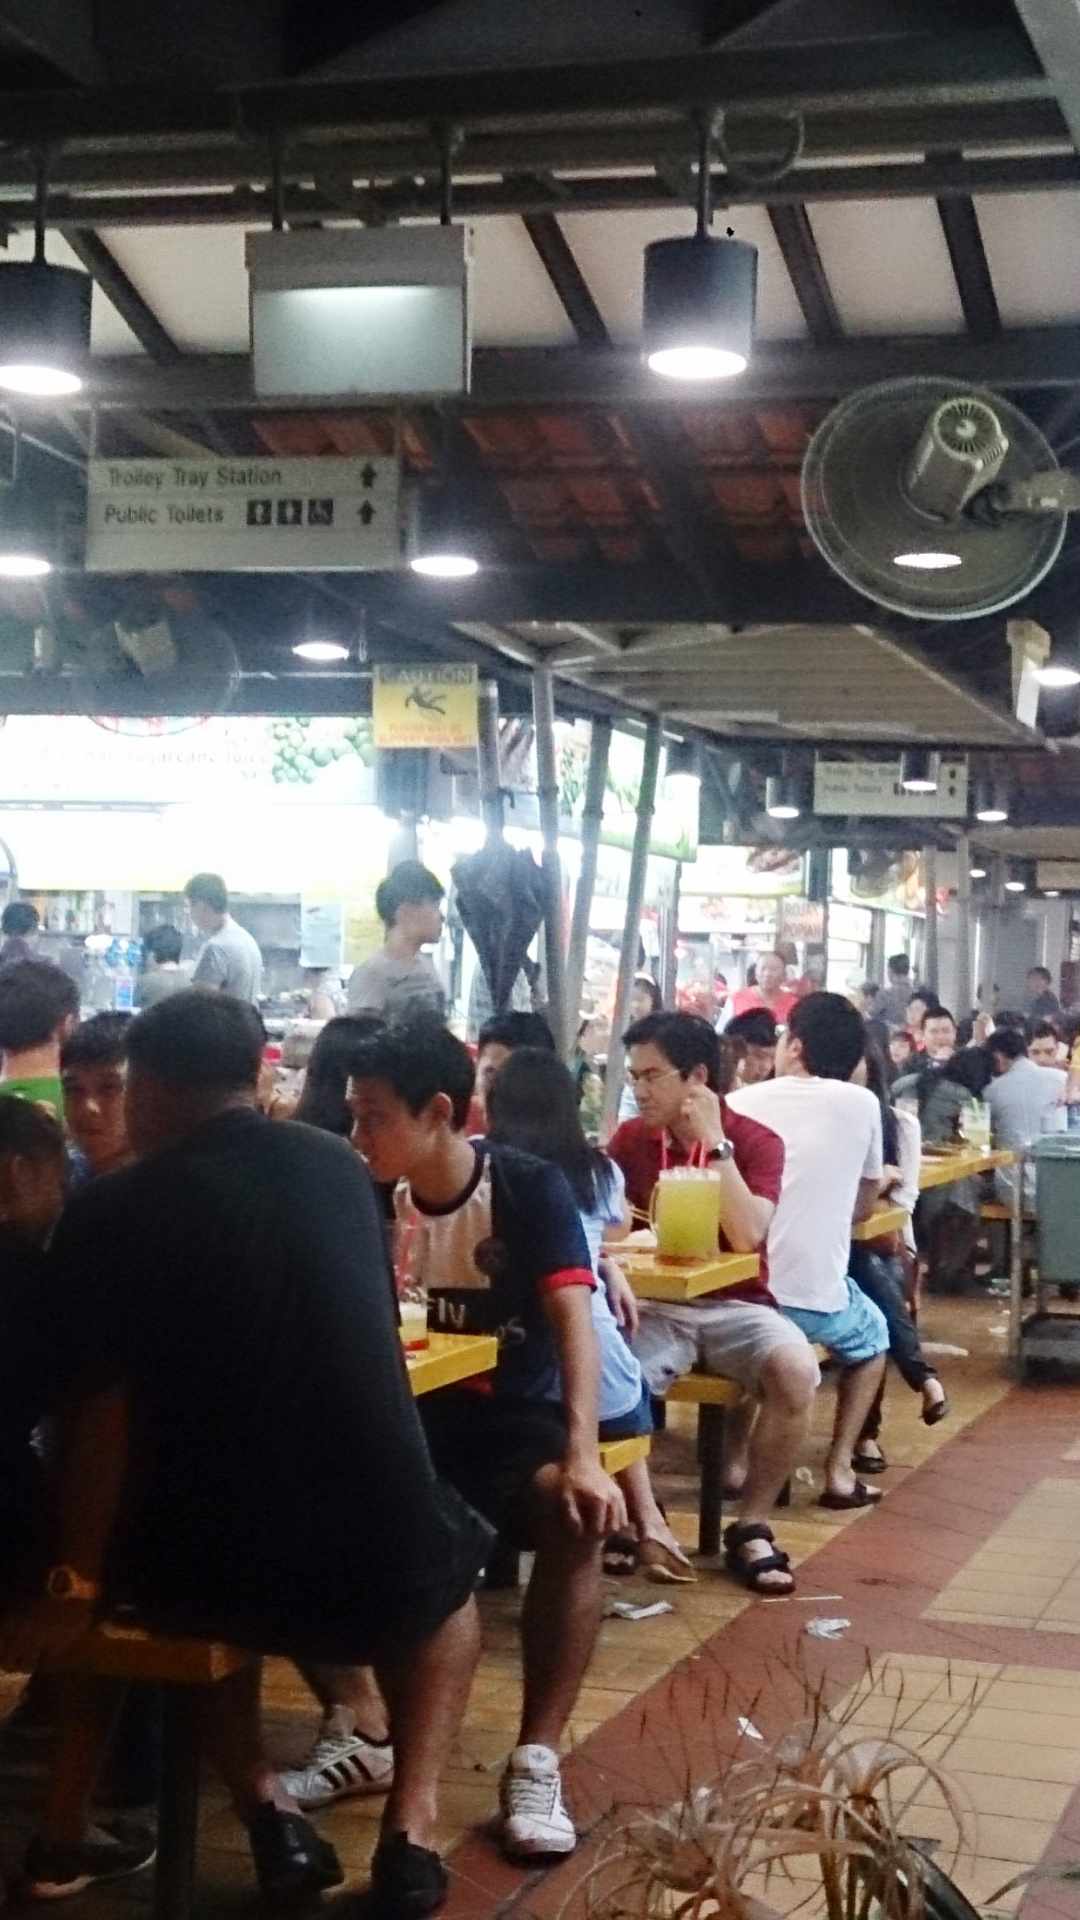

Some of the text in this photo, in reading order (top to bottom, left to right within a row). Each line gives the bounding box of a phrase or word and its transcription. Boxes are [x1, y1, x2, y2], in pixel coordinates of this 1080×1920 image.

[108, 465, 282, 488] Trolley Tray Station
[105, 503, 224, 523] Public Toilets
